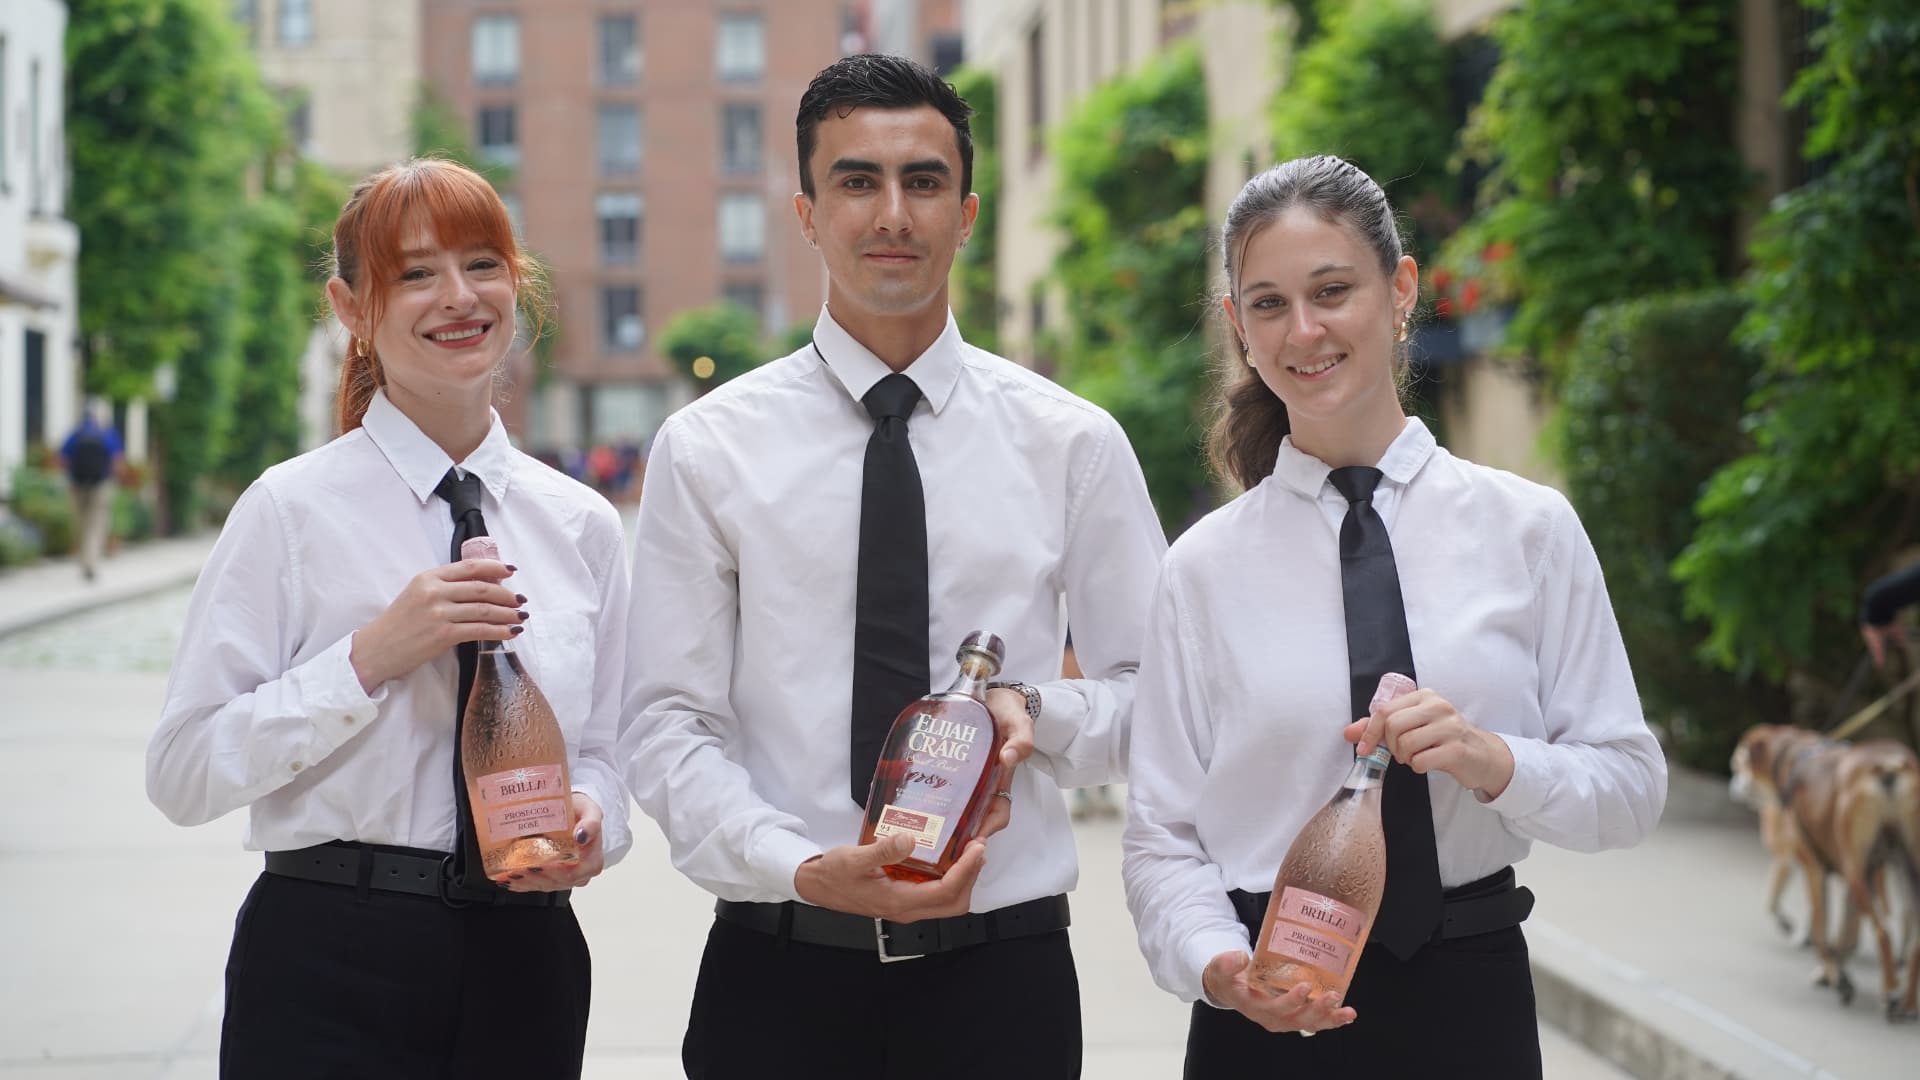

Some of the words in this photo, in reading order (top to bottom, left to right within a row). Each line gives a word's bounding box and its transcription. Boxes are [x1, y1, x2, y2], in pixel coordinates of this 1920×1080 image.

[914, 713, 978, 742] ELIJAH
[908, 732, 970, 761] CRAIG
[500, 780, 546, 796] BRILLA!
[504, 807, 549, 820] PROSECCO
[1301, 905, 1346, 929] BRILLA!
[1291, 931, 1336, 951] PROSECCO
